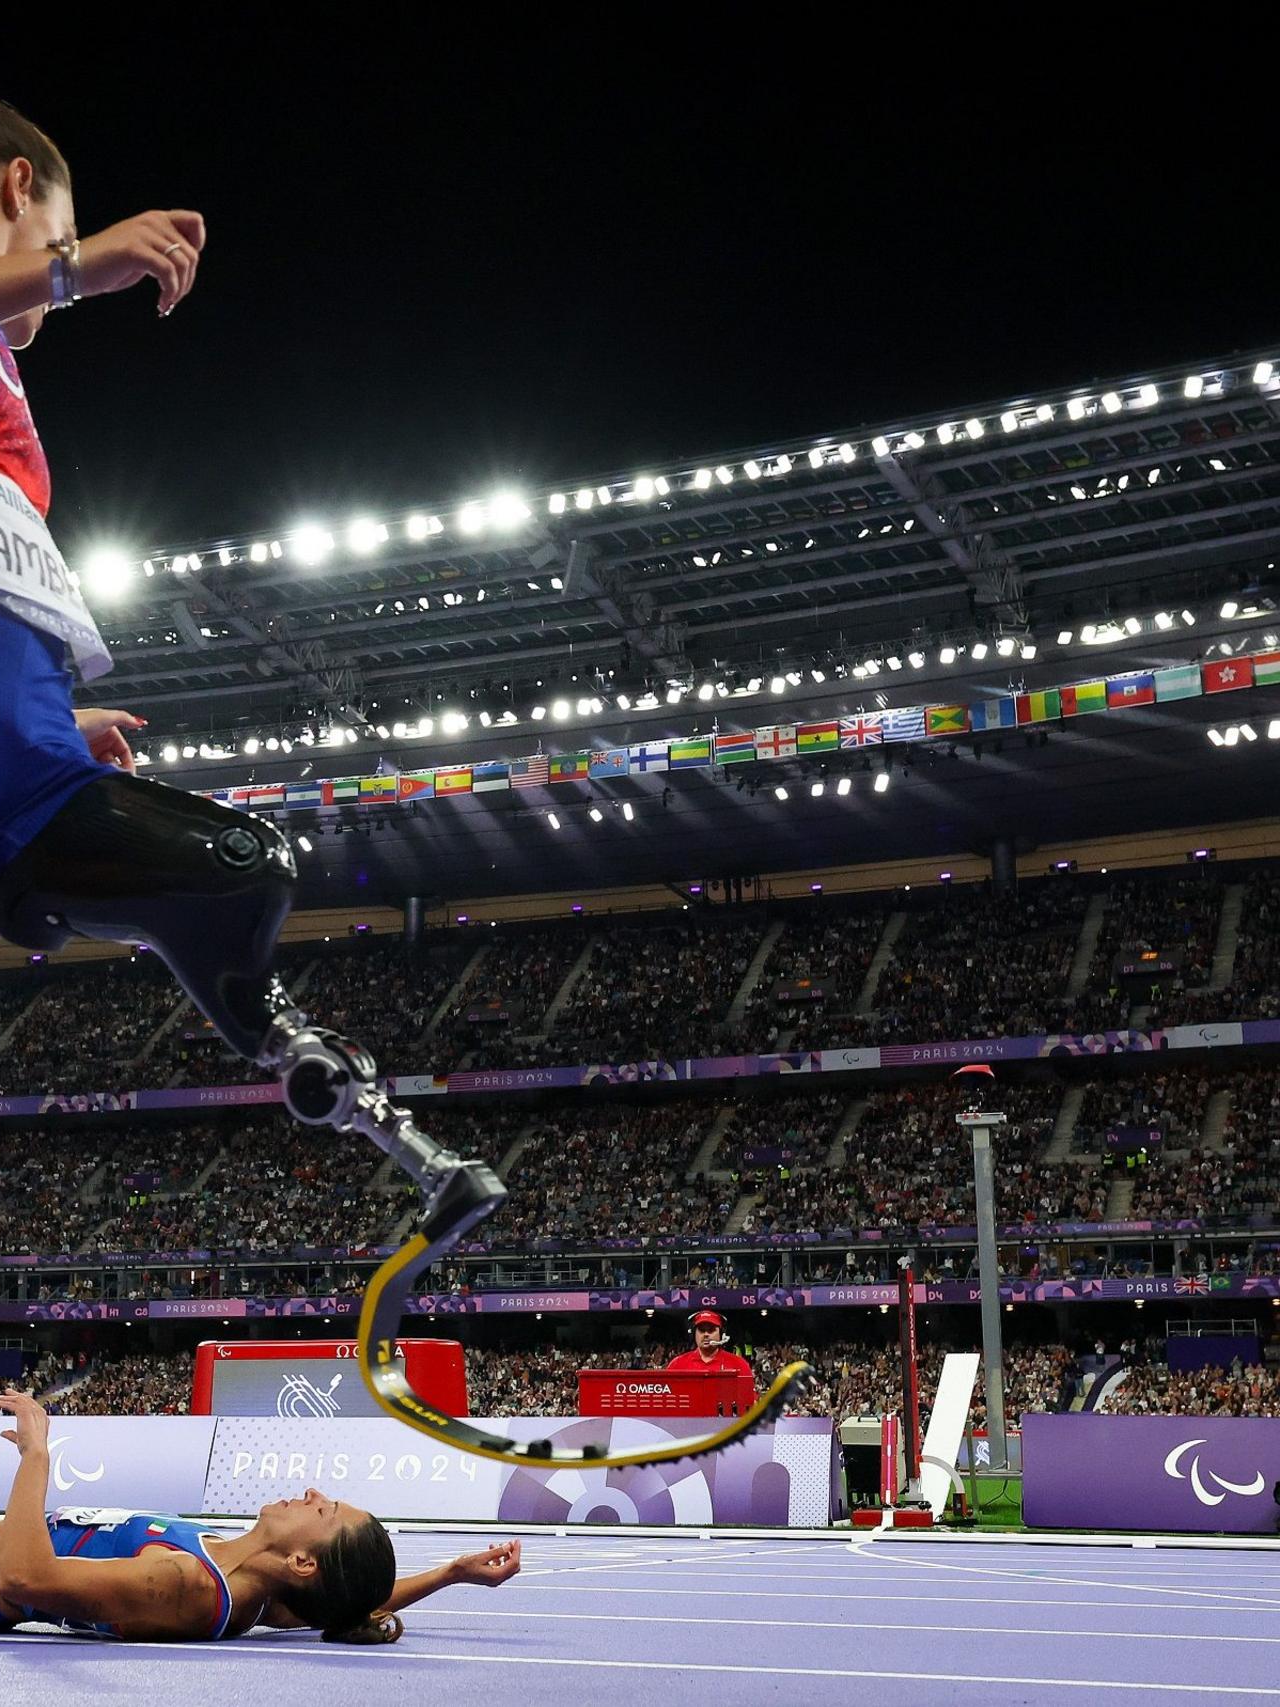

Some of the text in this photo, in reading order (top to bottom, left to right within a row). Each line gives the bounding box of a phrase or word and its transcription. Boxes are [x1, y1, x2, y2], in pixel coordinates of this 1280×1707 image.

[963, 1045, 1004, 1057] 2024
[517, 1073, 553, 1083] 2024
[873, 1289, 898, 1299] 202
[538, 1297, 569, 1307] 2024
[200, 1304, 229, 1313] 2024
[629, 1383, 672, 1394] OMEGA
[367, 1454, 477, 1481] 2024
